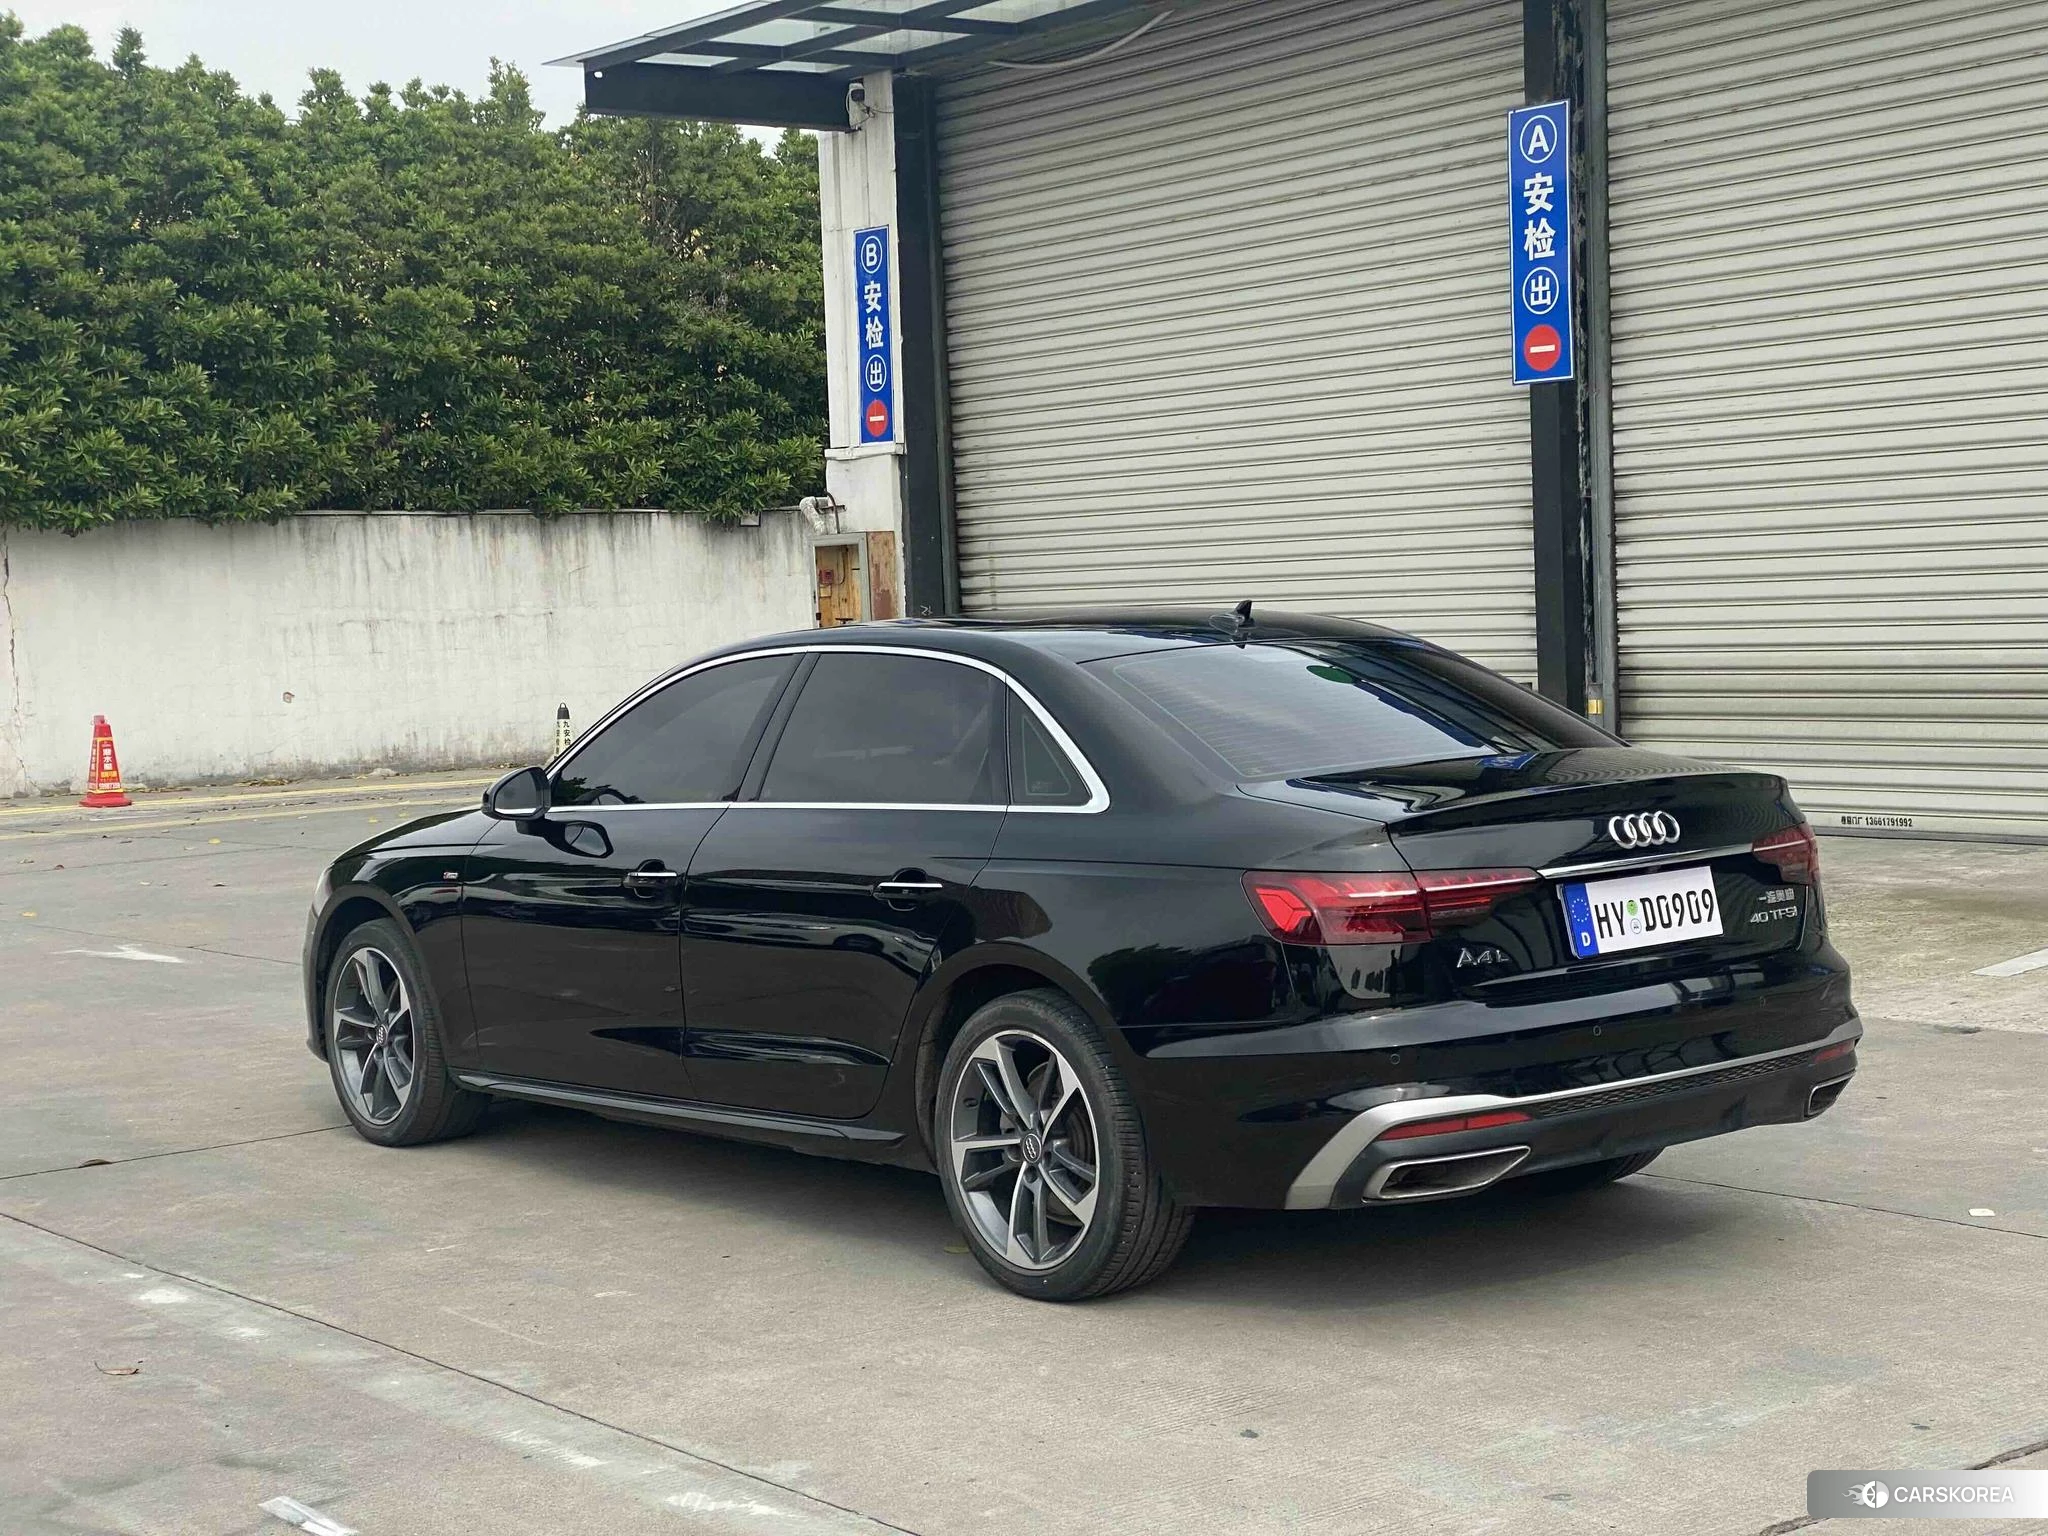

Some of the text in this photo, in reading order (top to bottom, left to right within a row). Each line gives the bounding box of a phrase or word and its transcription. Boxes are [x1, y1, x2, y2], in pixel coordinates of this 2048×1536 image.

[1527, 124, 1550, 156] A
[865, 243, 878, 267] B
[1594, 900, 1625, 939] HY
[1750, 905, 1798, 923] 40 TFSI
[1581, 932, 1591, 947] D
[1456, 947, 1509, 968] A4L
